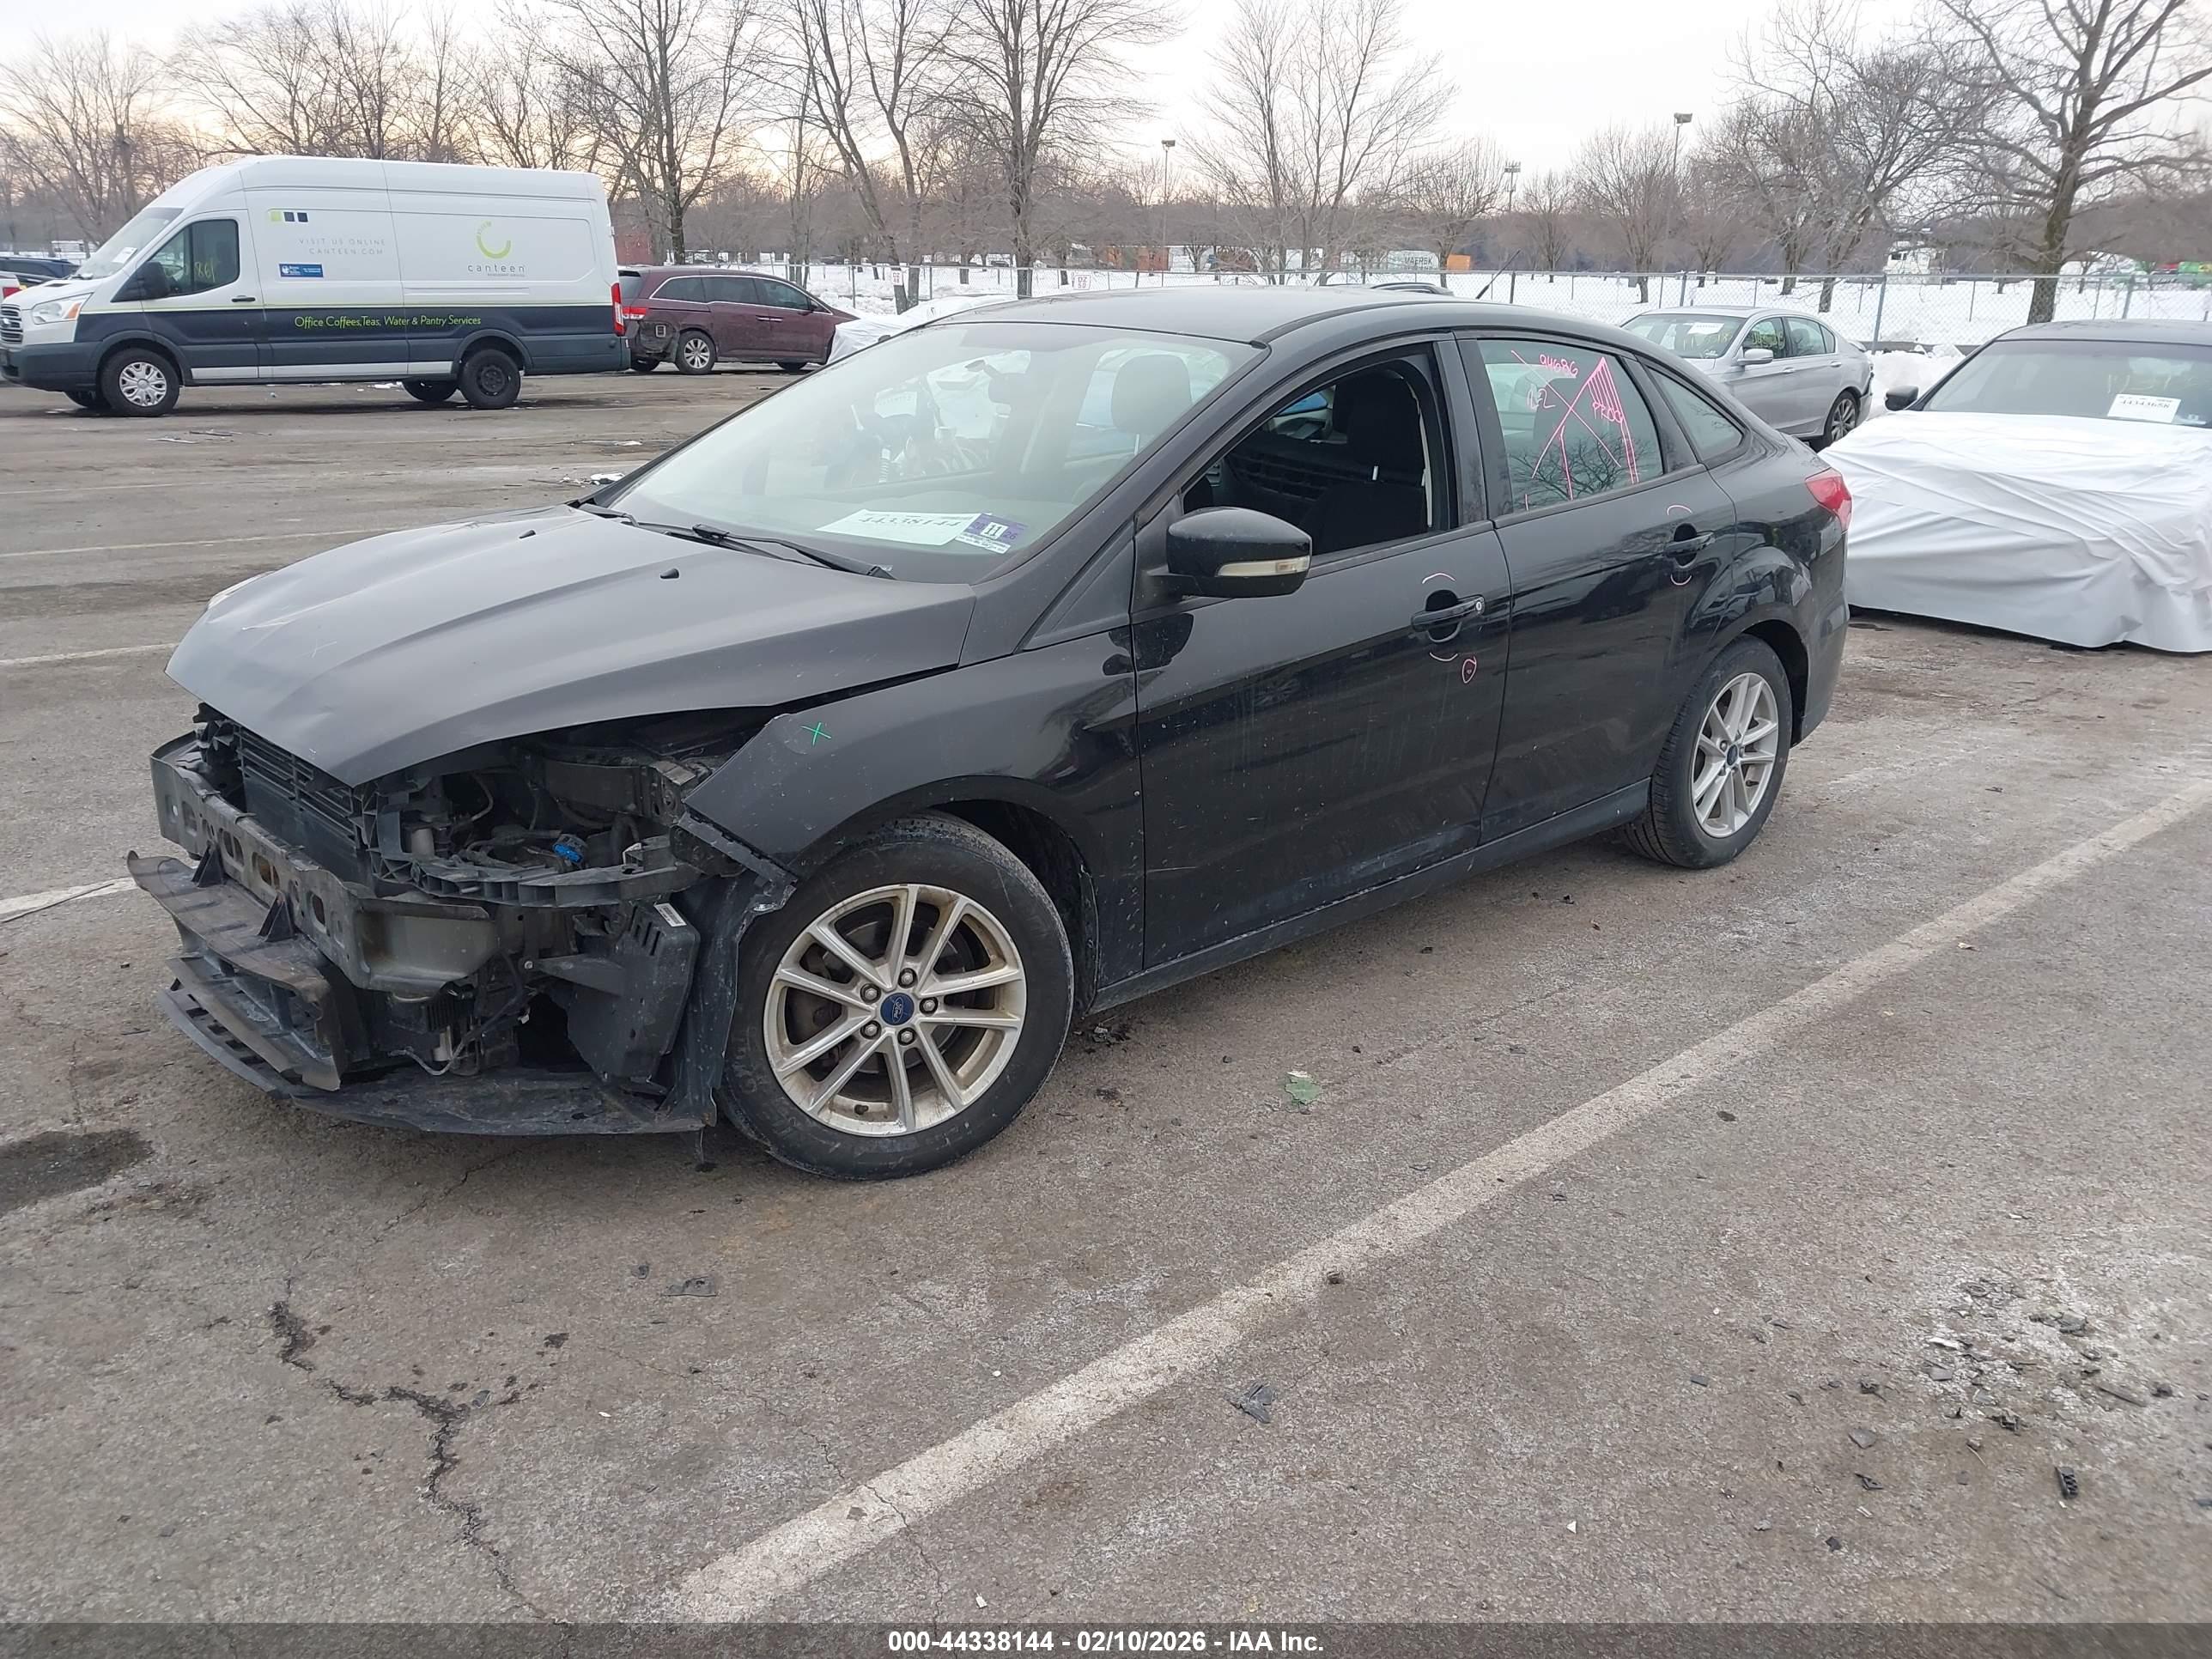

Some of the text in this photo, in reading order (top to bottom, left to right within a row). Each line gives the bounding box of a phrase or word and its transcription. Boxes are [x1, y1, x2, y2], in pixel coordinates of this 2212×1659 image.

[349, 238, 386, 246] ONLINE
[467, 264, 525, 273] canteen
[295, 316, 324, 329] Office
[384, 315, 410, 326] Water
[411, 317, 418, 325] &
[421, 315, 447, 327] Pantry
[448, 314, 482, 325] Services
[984, 525, 1003, 537] 11
